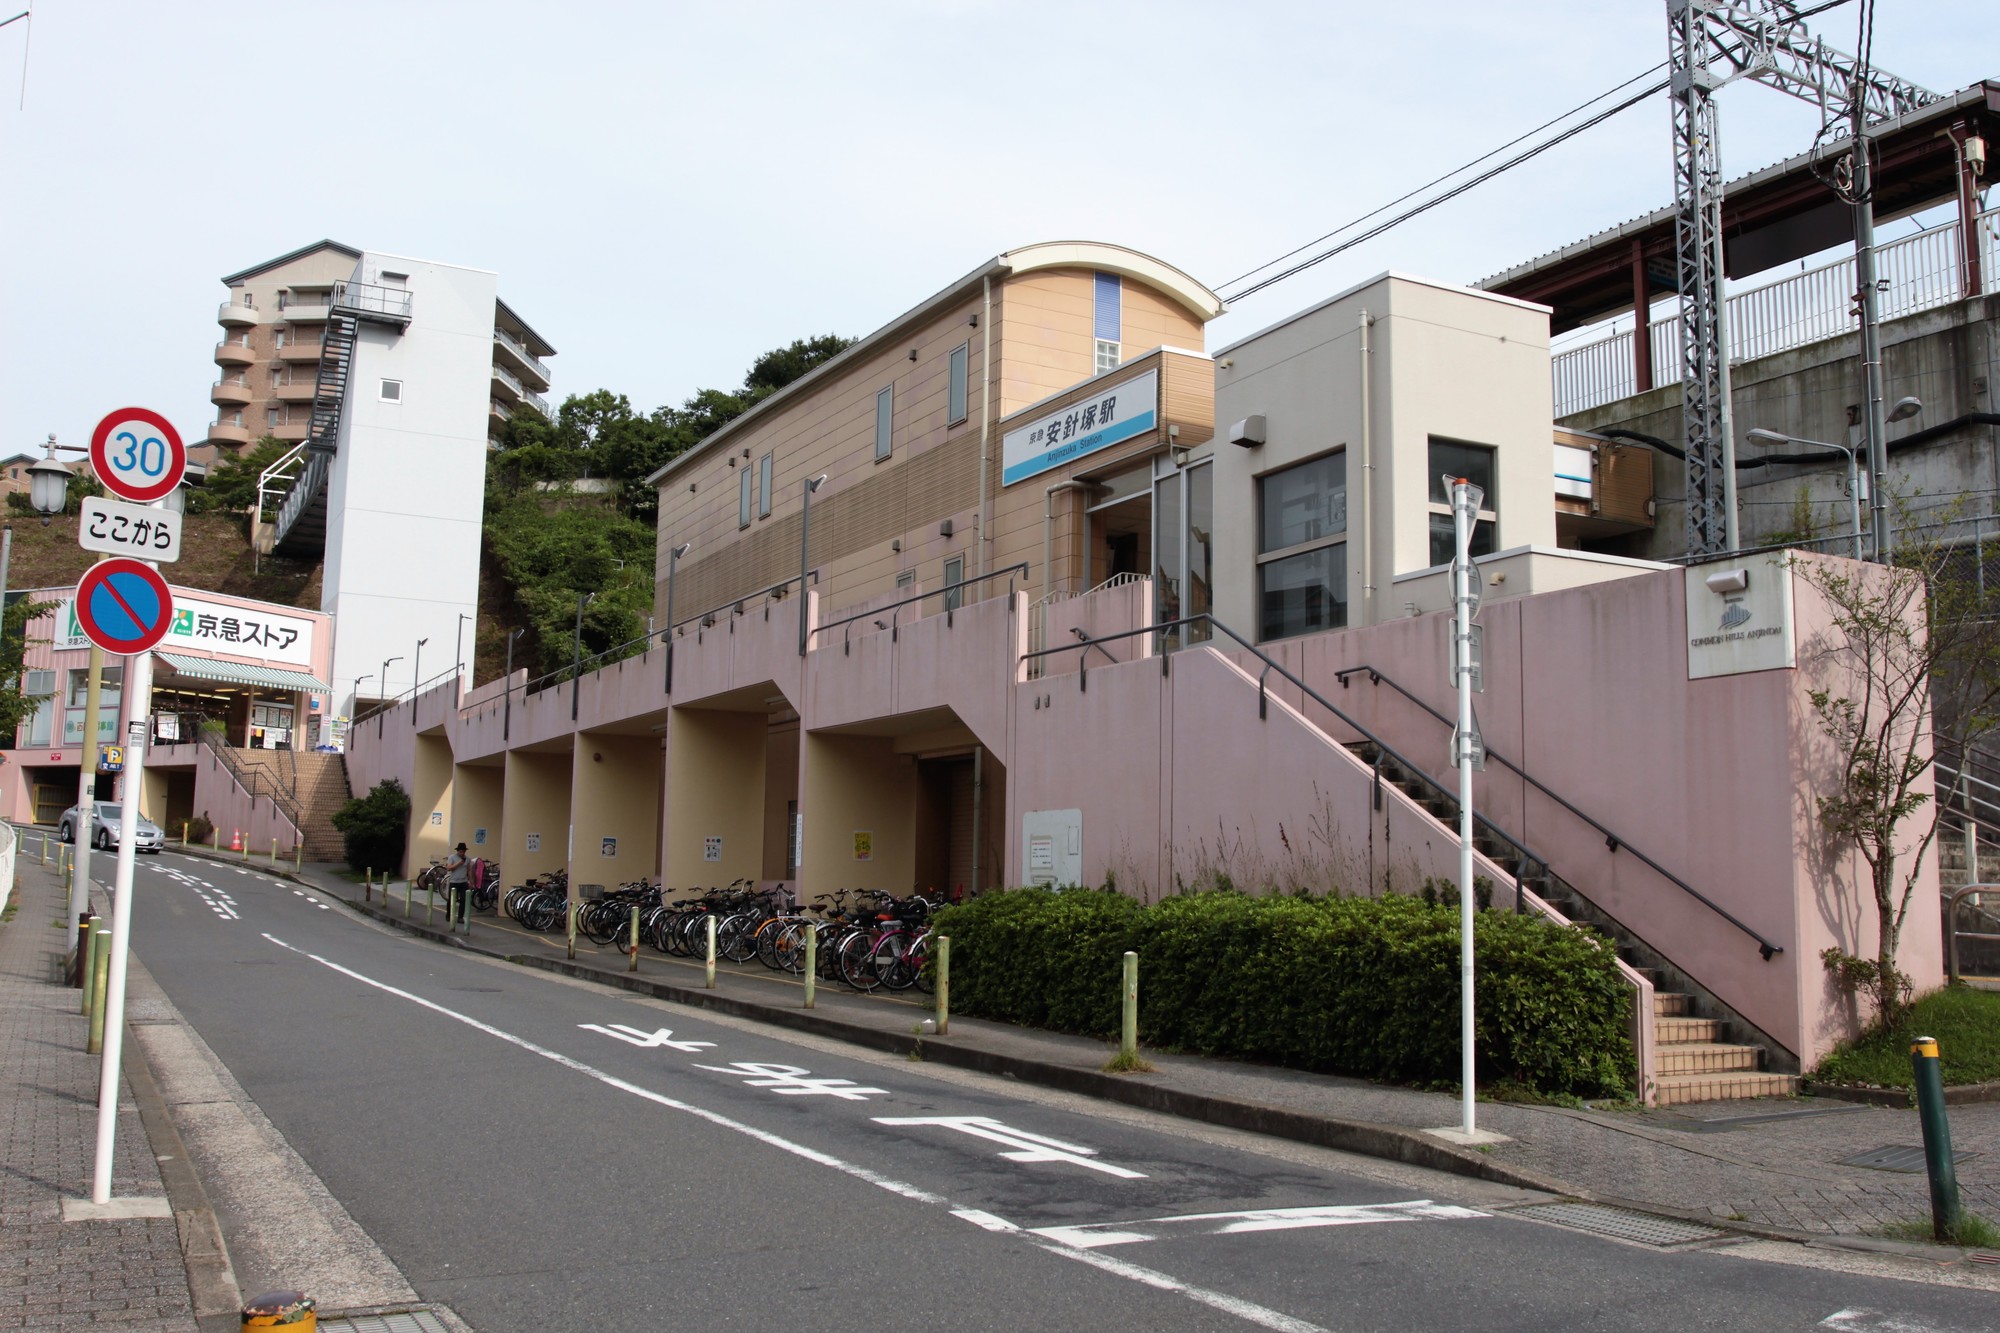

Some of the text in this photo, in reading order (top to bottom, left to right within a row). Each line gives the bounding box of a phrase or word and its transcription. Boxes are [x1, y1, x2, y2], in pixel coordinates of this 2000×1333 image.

[1028, 395, 1117, 448] 京急 安針塚駅
[112, 430, 166, 477] 30
[1047, 433, 1103, 463] Anjinzuka Station
[88, 511, 172, 550] ここから
[195, 614, 298, 650] 京急ストア
[1691, 626, 1782, 647] COMMON HILLS ANJINDAI
